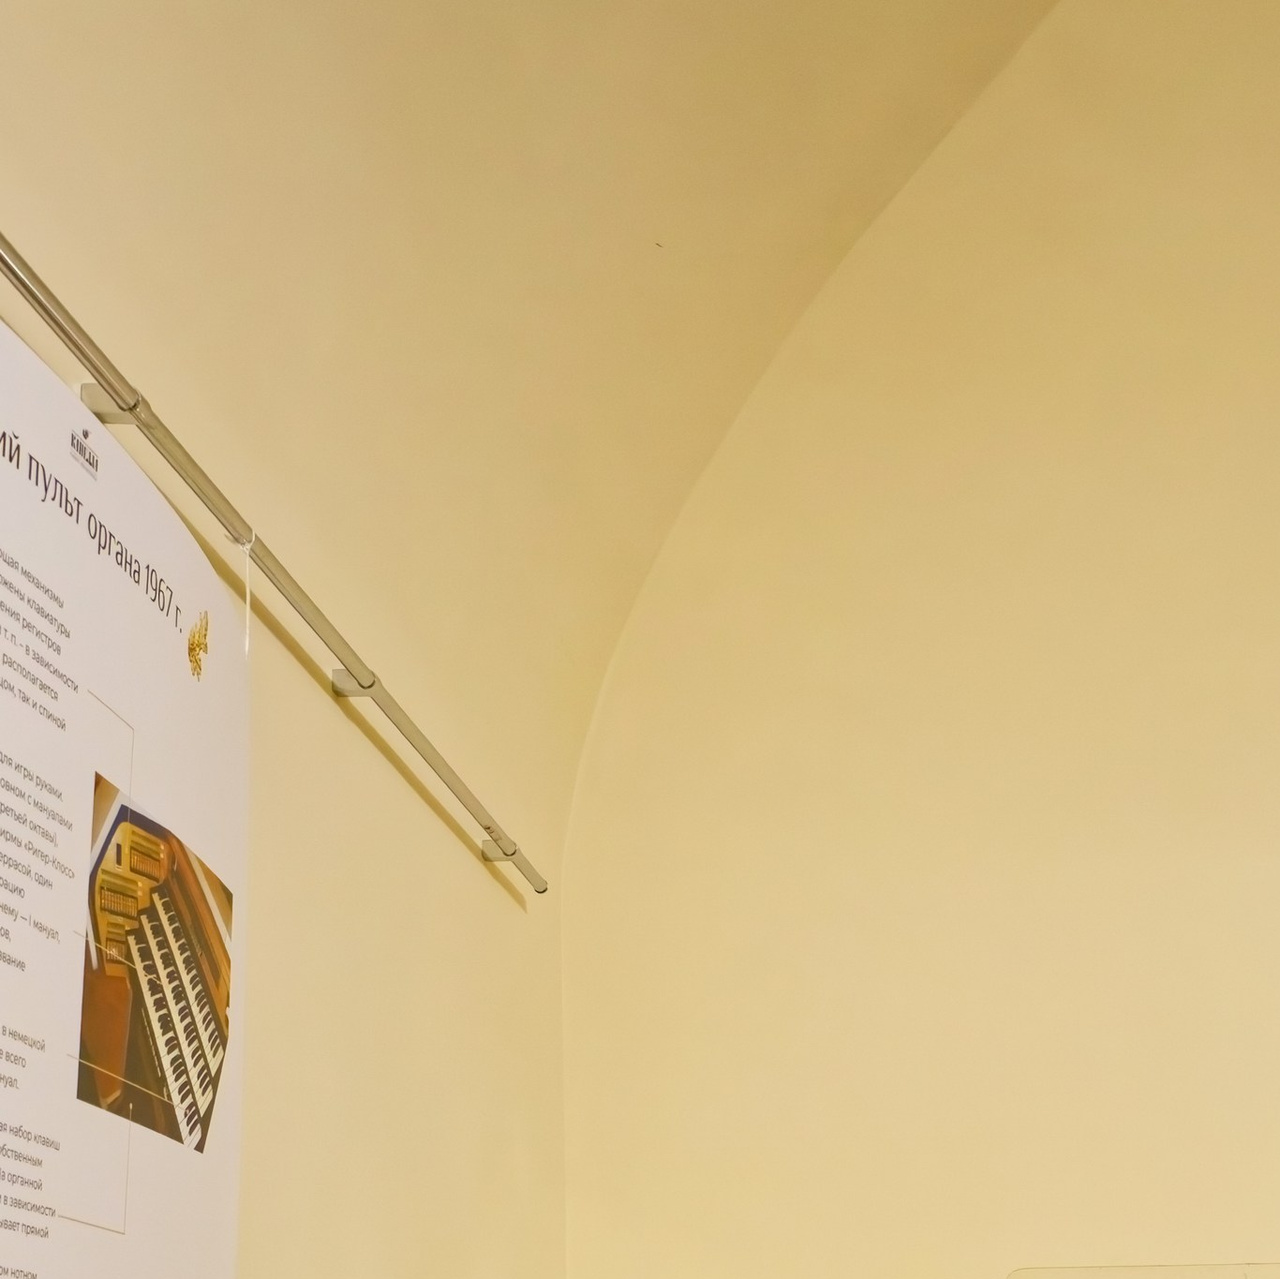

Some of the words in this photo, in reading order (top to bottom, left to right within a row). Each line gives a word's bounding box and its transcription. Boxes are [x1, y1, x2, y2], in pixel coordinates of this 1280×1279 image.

[28, 452, 84, 525] пульт
[87, 513, 141, 587] органа
[145, 564, 173, 618] 1967
[174, 604, 182, 634] г.
[20, 565, 65, 609] механизмы
[22, 617, 62, 656] регистров
[26, 595, 71, 639] клавиатуры
[2, 652, 59, 702] располагается
[31, 649, 79, 694] зависимости
[18, 688, 31, 706] так
[38, 704, 67, 731] спиной
[14, 761, 35, 783] игры
[5, 1050, 27, 1068] всего
[9, 1124, 33, 1143] набор
[33, 1133, 61, 1152] клавиш
[6, 1172, 43, 1191] органной
[9, 1196, 56, 1217] зависимости
[21, 1222, 49, 1238] прямой
